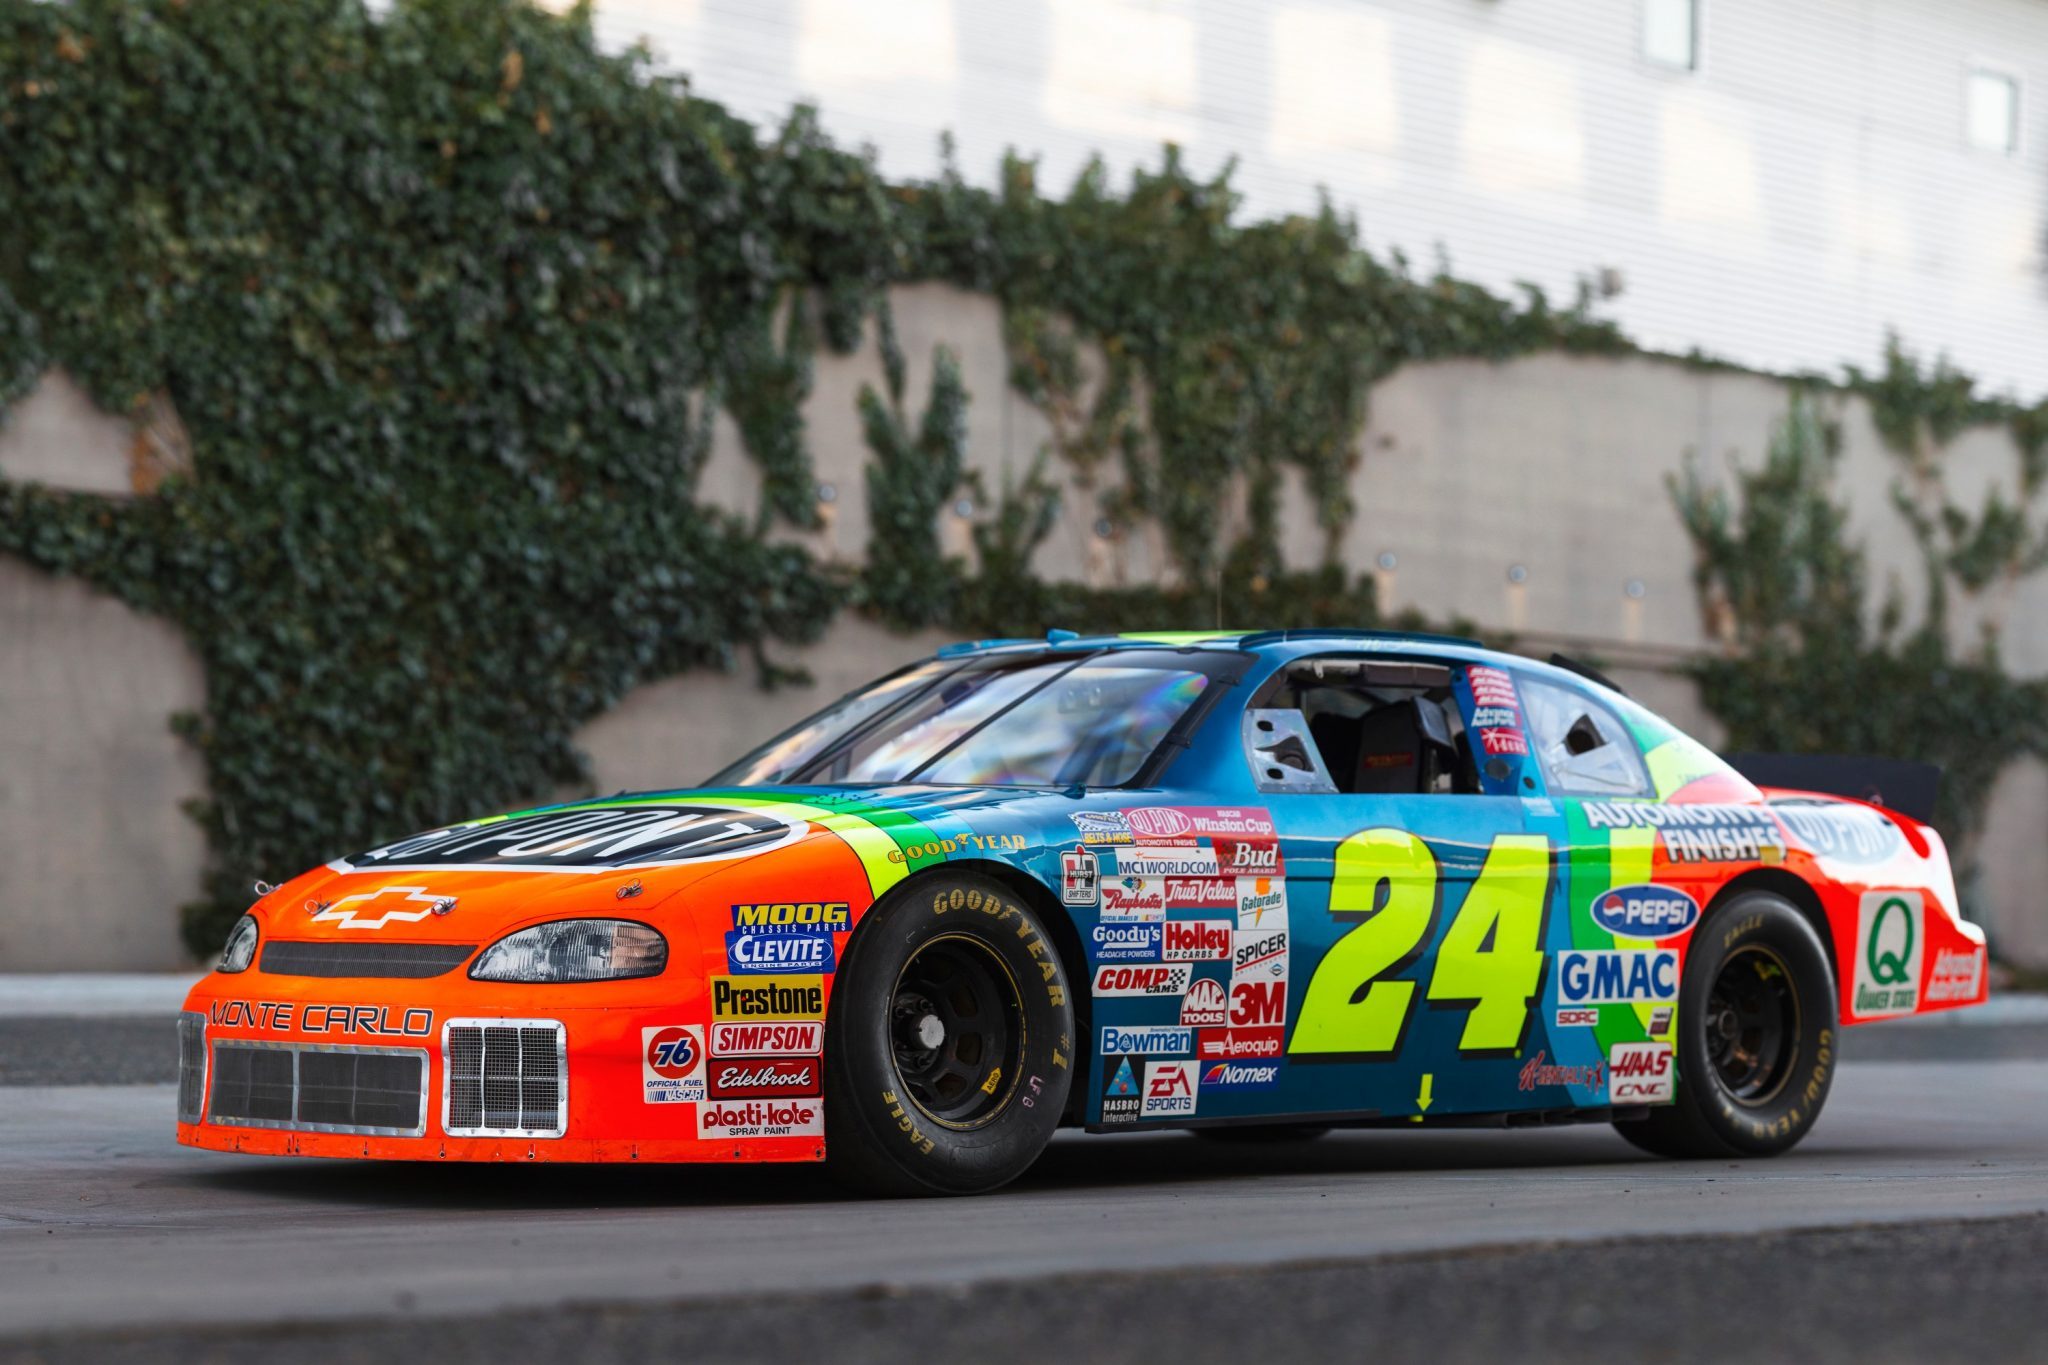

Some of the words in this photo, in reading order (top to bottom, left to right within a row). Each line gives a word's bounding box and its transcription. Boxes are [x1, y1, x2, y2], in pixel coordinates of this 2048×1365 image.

[1192, 817, 1245, 833] Winston
[1245, 818, 1273, 835] Cup
[1582, 802, 1772, 829] AUTOMOTIVE
[1083, 832, 1106, 844] BELTS
[1136, 839, 1173, 847] AUTOMOTIVE
[1173, 839, 1198, 847] FINISHES
[1661, 829, 1786, 863] FINISHES
[1232, 842, 1278, 868] Bud
[1070, 870, 1093, 879] HURST
[1068, 889, 1092, 898] SHIFTERS
[1101, 888, 1163, 915] Raybestos
[1241, 892, 1282, 911] Gatorade
[737, 903, 848, 926] MOOG
[1626, 898, 1689, 925] PEPSI
[742, 924, 797, 934] CHASSIS
[807, 922, 847, 932] PARTS
[1093, 925, 1161, 949] Goody's
[735, 934, 824, 963] CLEVITE
[1166, 922, 1229, 958] Holley
[1236, 932, 1286, 966] SPICER
[1287, 827, 1551, 1057] 24
[1867, 897, 1914, 986] Q
[1096, 950, 1127, 959] HEADACHE
[1128, 950, 1155, 958] POWDERS
[1167, 951, 1179, 959] HP
[1182, 950, 1213, 959] CARBS
[1098, 968, 1169, 990] COMP
[1146, 984, 1179, 993] CAMS
[1561, 953, 1675, 1001] GMAC
[714, 980, 822, 1015] Prestone
[1230, 981, 1286, 1026] 3M
[209, 1001, 294, 1031] MONTE
[301, 1005, 434, 1037] CARLO
[1182, 1013, 1224, 1023] TOOLS
[1558, 1011, 1597, 1025] SDRC
[718, 1026, 815, 1051] SIMPSON
[1219, 1031, 1279, 1056] Aeroquip
[654, 1037, 694, 1067] 76
[1610, 1050, 1673, 1077] HAAS
[646, 1080, 682, 1088] OFFICIAL
[684, 1079, 704, 1087] FUEL
[717, 1066, 811, 1090] Edelbrock
[986, 1072, 1000, 1090] AERO
[1220, 1066, 1278, 1084] Nomex
[1616, 1083, 1666, 1097] CNC
[703, 1101, 815, 1130] plasti-kote
[1103, 1100, 1139, 1111] HASBRO
[1146, 1097, 1191, 1111] SPORTS
[882, 1089, 936, 1155] EAGLE
[1102, 1111, 1137, 1123] Interactive
[729, 1127, 760, 1136] SPRAY
[764, 1126, 792, 1135] PAINT
